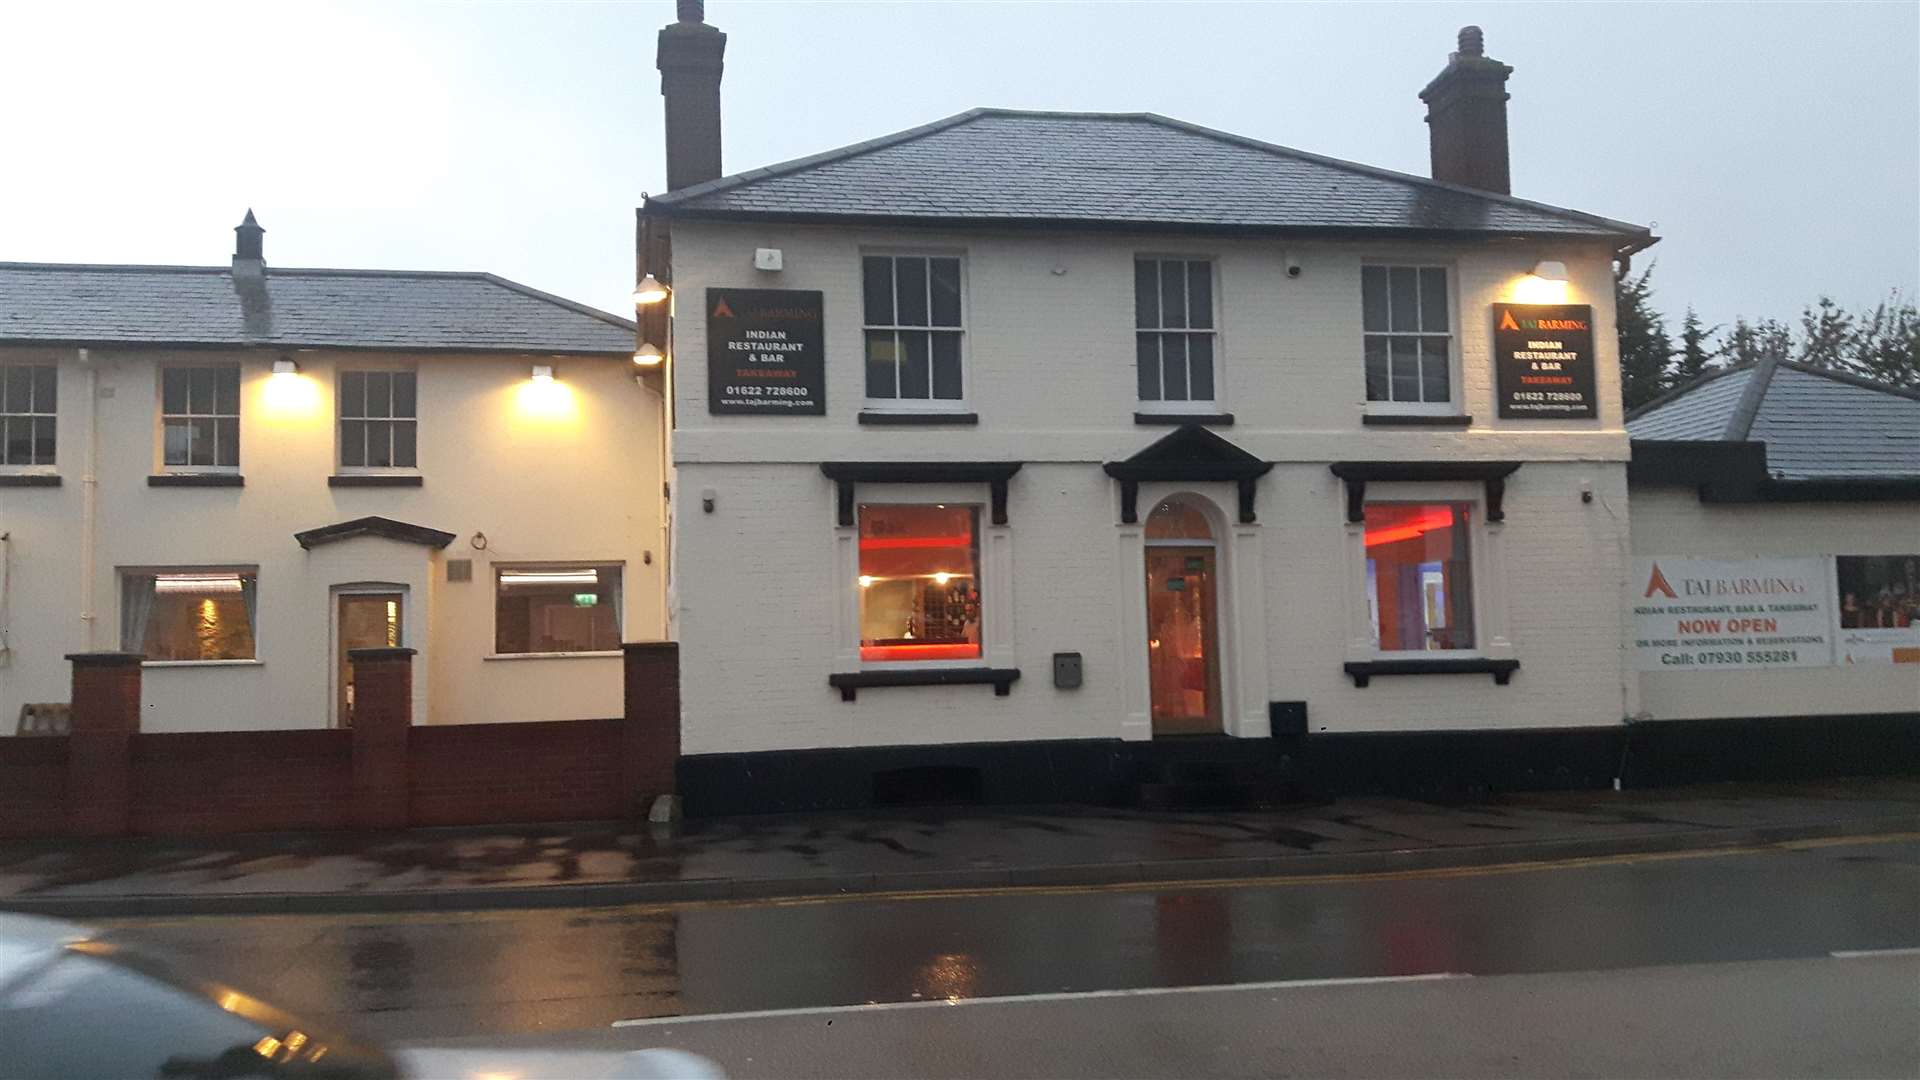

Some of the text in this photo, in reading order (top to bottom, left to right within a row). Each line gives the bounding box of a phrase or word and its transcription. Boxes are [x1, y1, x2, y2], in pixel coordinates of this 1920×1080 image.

[1538, 319, 1588, 331] BARMING
[745, 330, 786, 339] INDIAN
[728, 341, 804, 351] RESTAURANT
[1527, 341, 1562, 349] INDIAN
[748, 354, 784, 362] & BAR
[1513, 351, 1577, 360] RESTAURANT
[1531, 362, 1562, 370] & BAR
[735, 369, 798, 377] TAKEAWAY
[1521, 376, 1573, 384] TAKEAWAY
[726, 386, 808, 396] 01622 728600
[720, 398, 814, 407] www.tajbarming.com
[1683, 578, 1806, 596] TAJ BARMING
[1634, 606, 1664, 615] NDIAN
[1736, 604, 1755, 613] BAR
[1757, 604, 1765, 612] &
[1678, 618, 1777, 634] NOW OPEN
[1636, 639, 1649, 648] OR
[1652, 639, 1678, 647] MORE
[1681, 637, 1744, 647] INFORMATION
[1661, 650, 1798, 665] Call: 07930 555281
